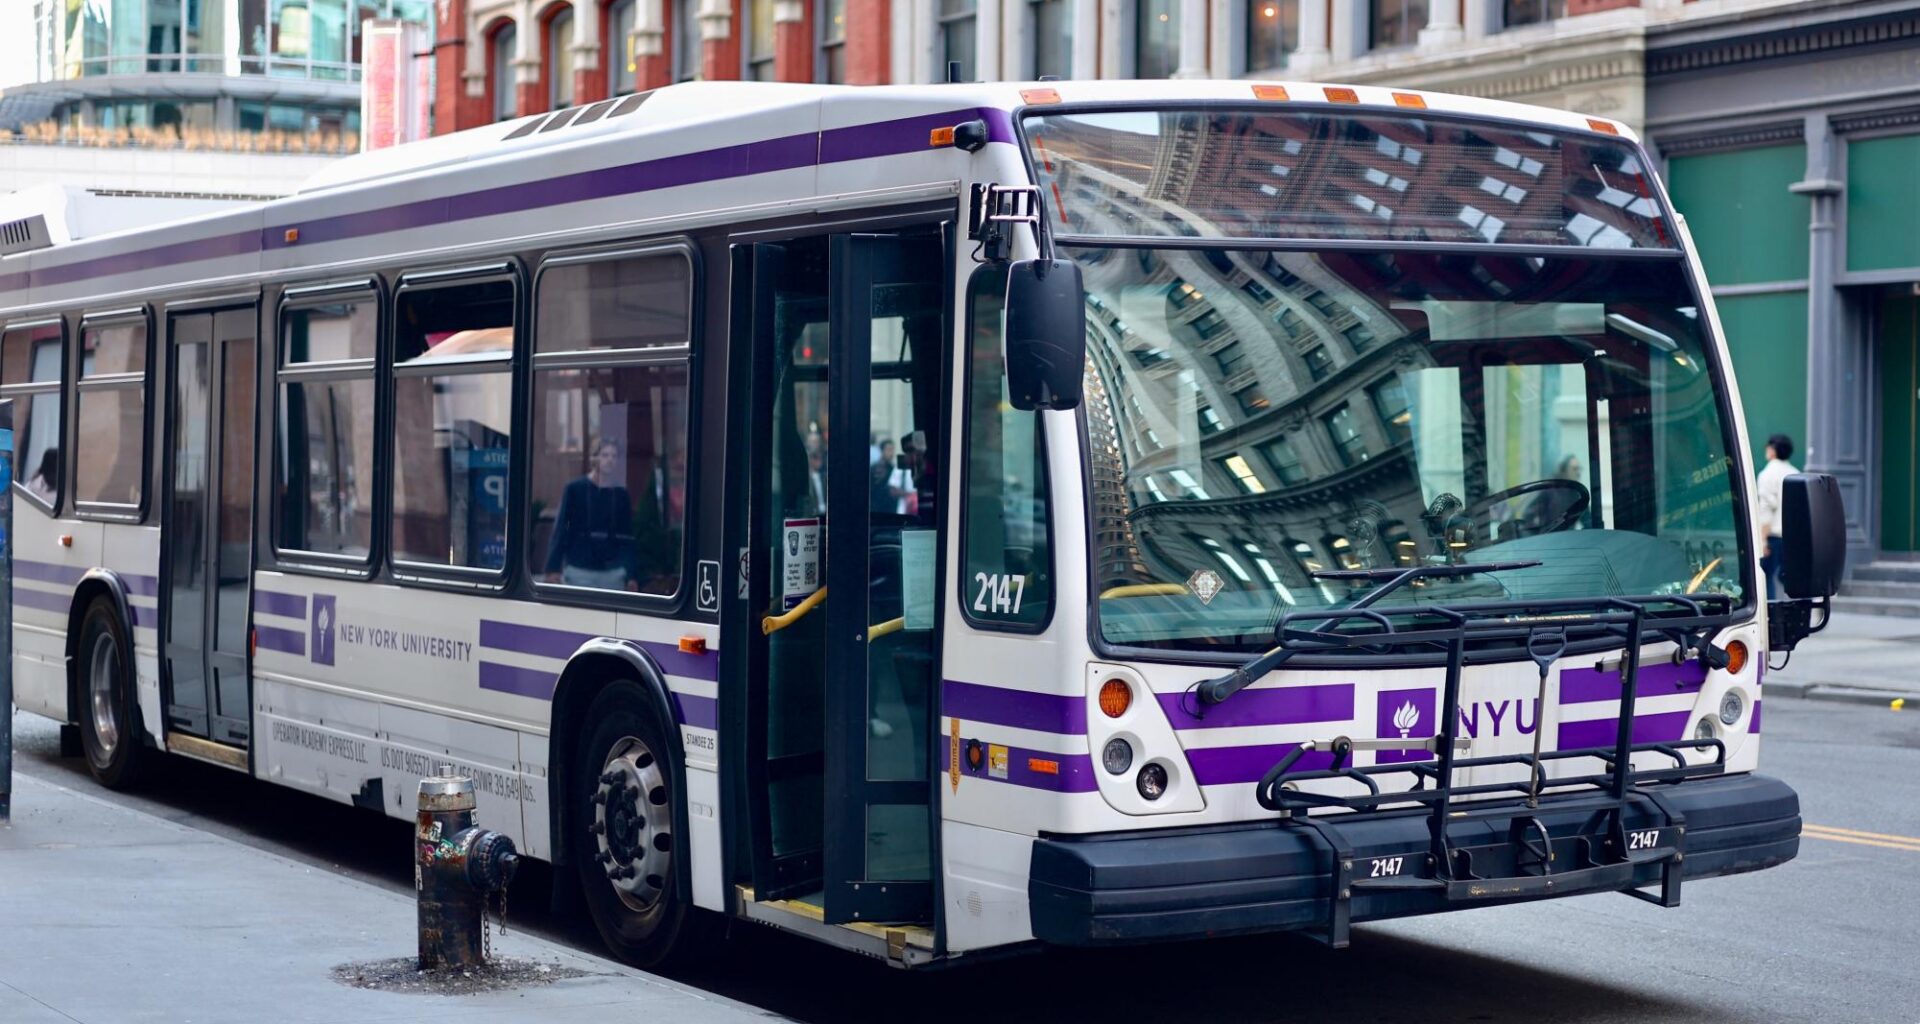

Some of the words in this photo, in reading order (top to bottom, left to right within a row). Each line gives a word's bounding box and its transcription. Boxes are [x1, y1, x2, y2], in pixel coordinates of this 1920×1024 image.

[974, 571, 1025, 614] 2147
[340, 623, 365, 644] NEW
[368, 627, 398, 650] YORK
[402, 632, 472, 663] UNIVERSITY
[1455, 698, 1539, 738] NYU
[271, 721, 300, 746] OPERATOR
[301, 728, 327, 753] ACADEMY
[328, 735, 354, 760] EXPRESS
[686, 733, 706, 749] STANDEE
[707, 737, 714, 750] 25
[381, 746, 390, 768] US
[391, 748, 403, 771] DOT
[1630, 831, 1660, 850] 2147
[1371, 857, 1404, 878] 2147
